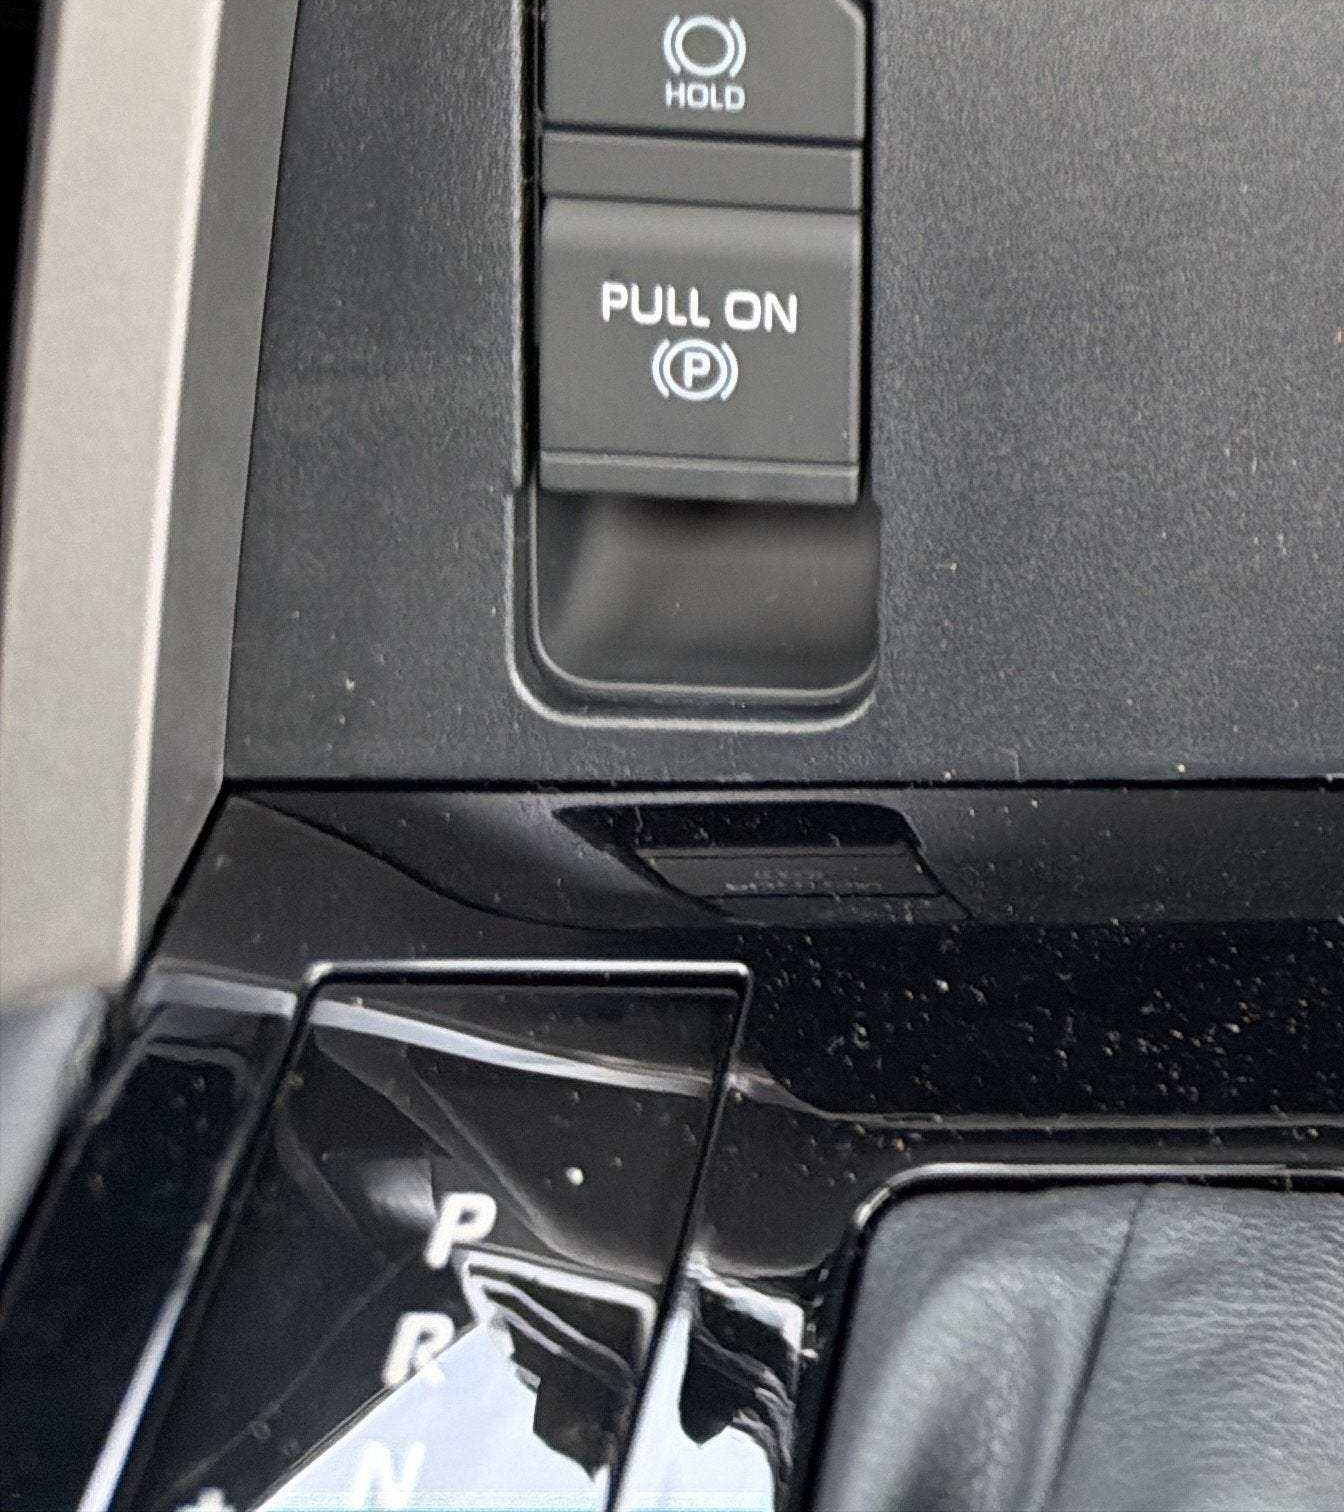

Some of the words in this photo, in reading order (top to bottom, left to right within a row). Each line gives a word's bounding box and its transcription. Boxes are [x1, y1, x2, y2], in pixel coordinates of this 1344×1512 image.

[665, 80, 746, 112] HOLD
[602, 281, 711, 329] PULL
[724, 290, 798, 333] ON
[424, 1191, 497, 1269] P
[382, 1311, 454, 1388] R
[349, 1441, 426, 1512] N
